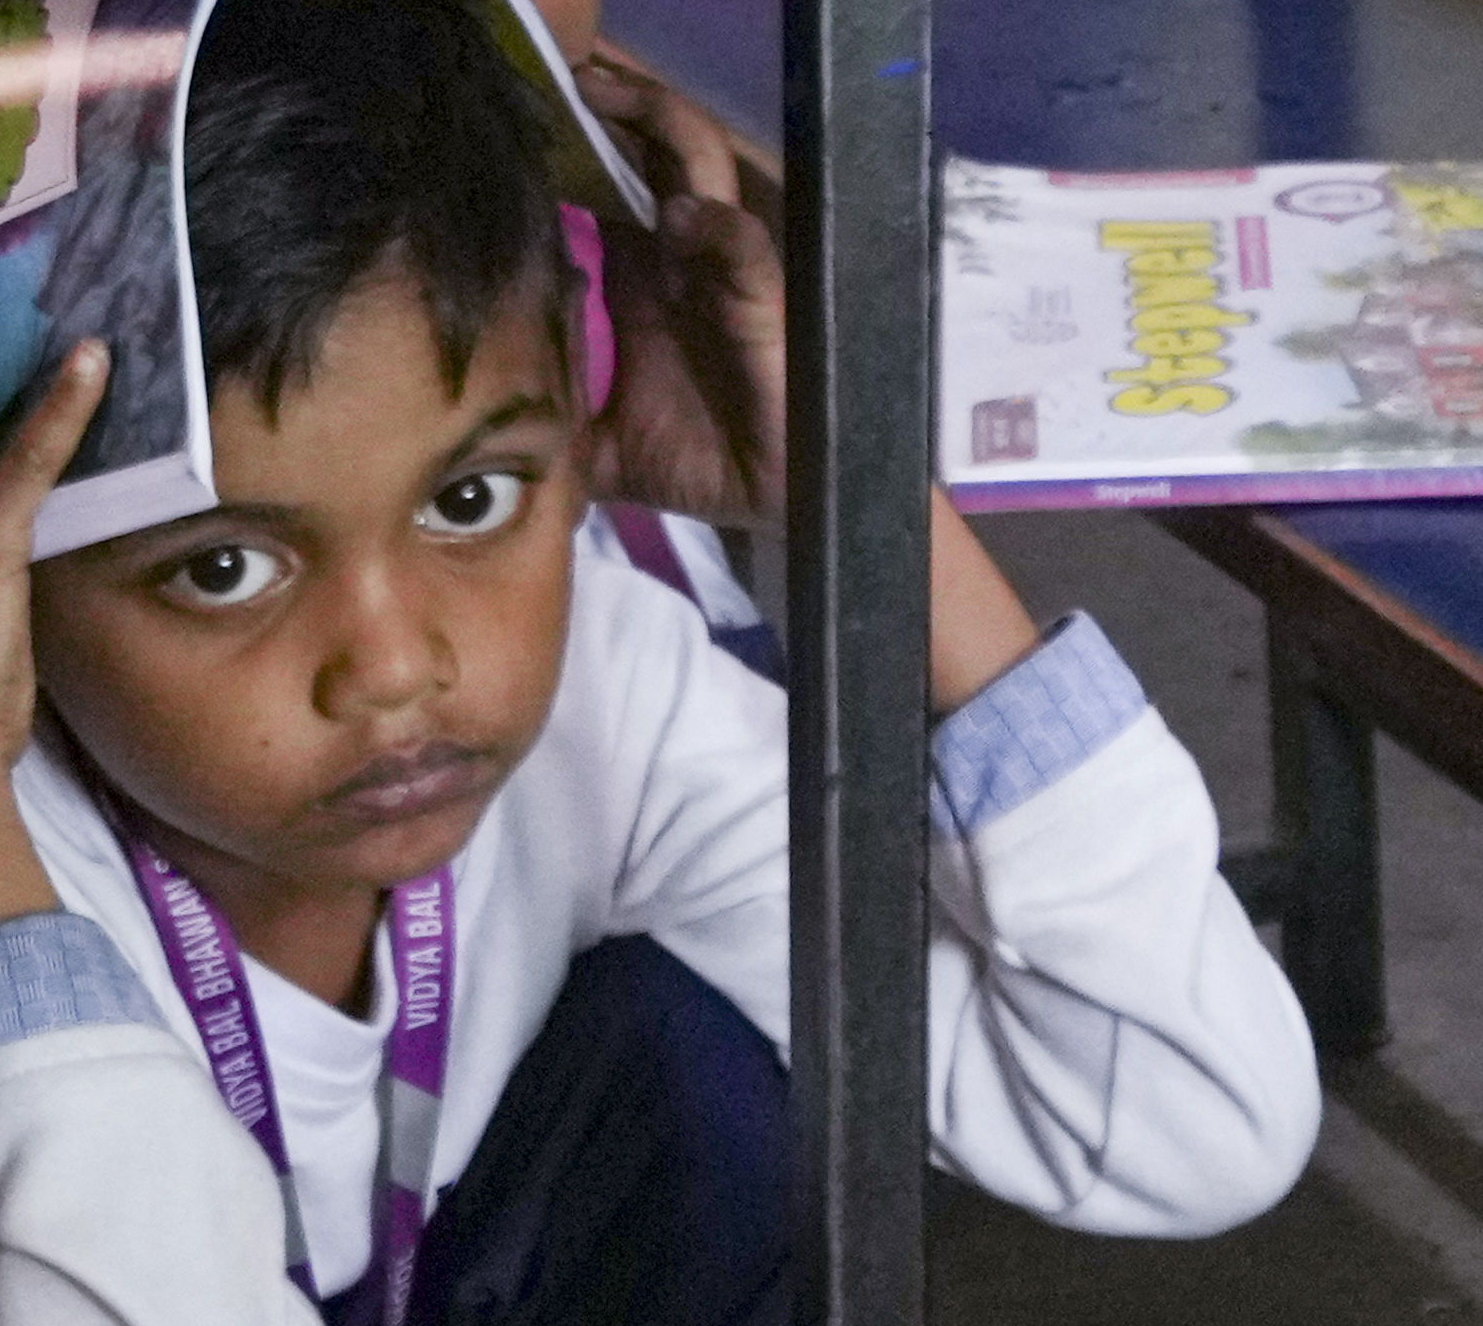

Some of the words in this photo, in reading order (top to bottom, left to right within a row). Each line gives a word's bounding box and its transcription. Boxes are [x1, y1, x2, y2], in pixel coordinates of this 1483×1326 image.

[1100, 220, 1257, 416] Stepwell
[164, 878, 234, 999] BHAWAN
[406, 883, 442, 938] BAL
[202, 1001, 249, 1053] BAL
[406, 945, 442, 1030] VIDYA
[219, 1055, 267, 1129] VIDYA
